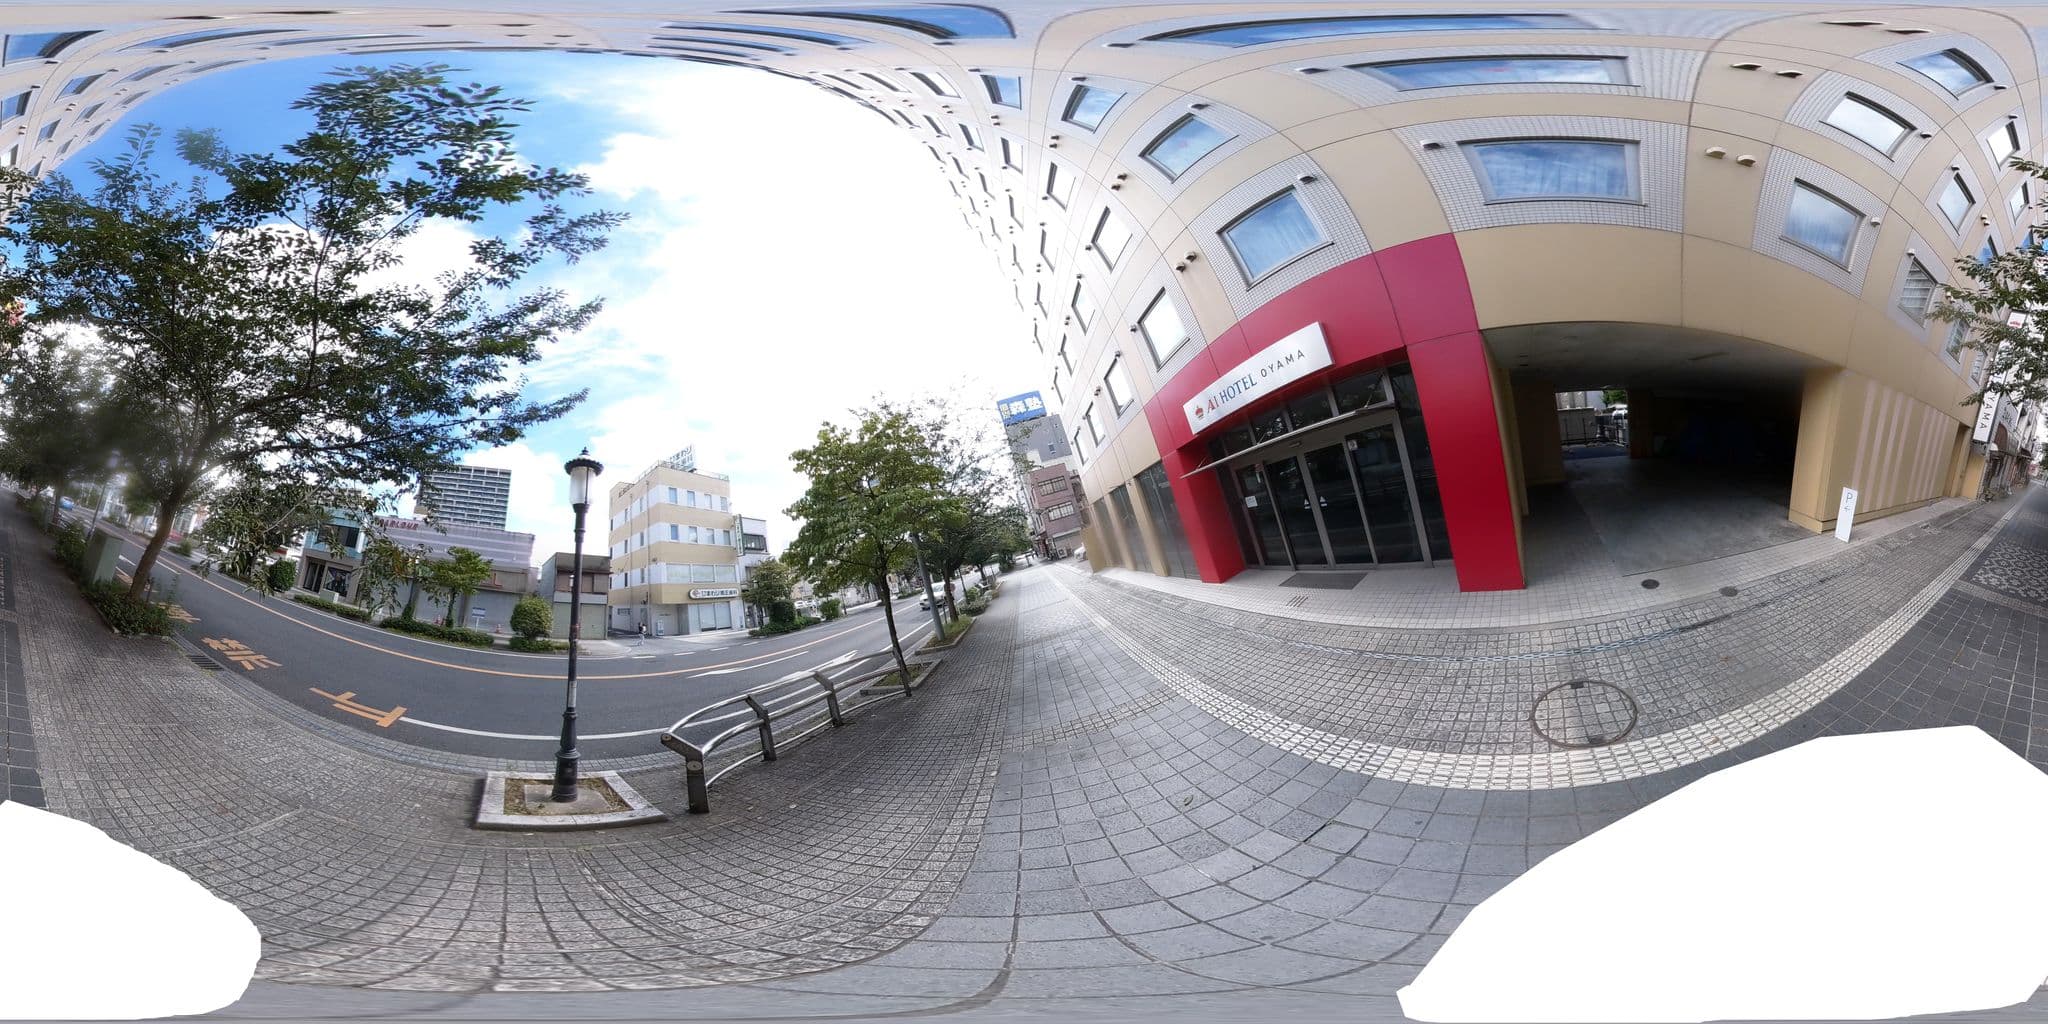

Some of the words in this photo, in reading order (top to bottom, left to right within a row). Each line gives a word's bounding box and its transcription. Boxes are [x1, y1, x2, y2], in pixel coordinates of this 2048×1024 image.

[1219, 373, 1257, 404] HOTEL
[1260, 349, 1304, 378] OYAMA
[1845, 492, 1853, 503] P
